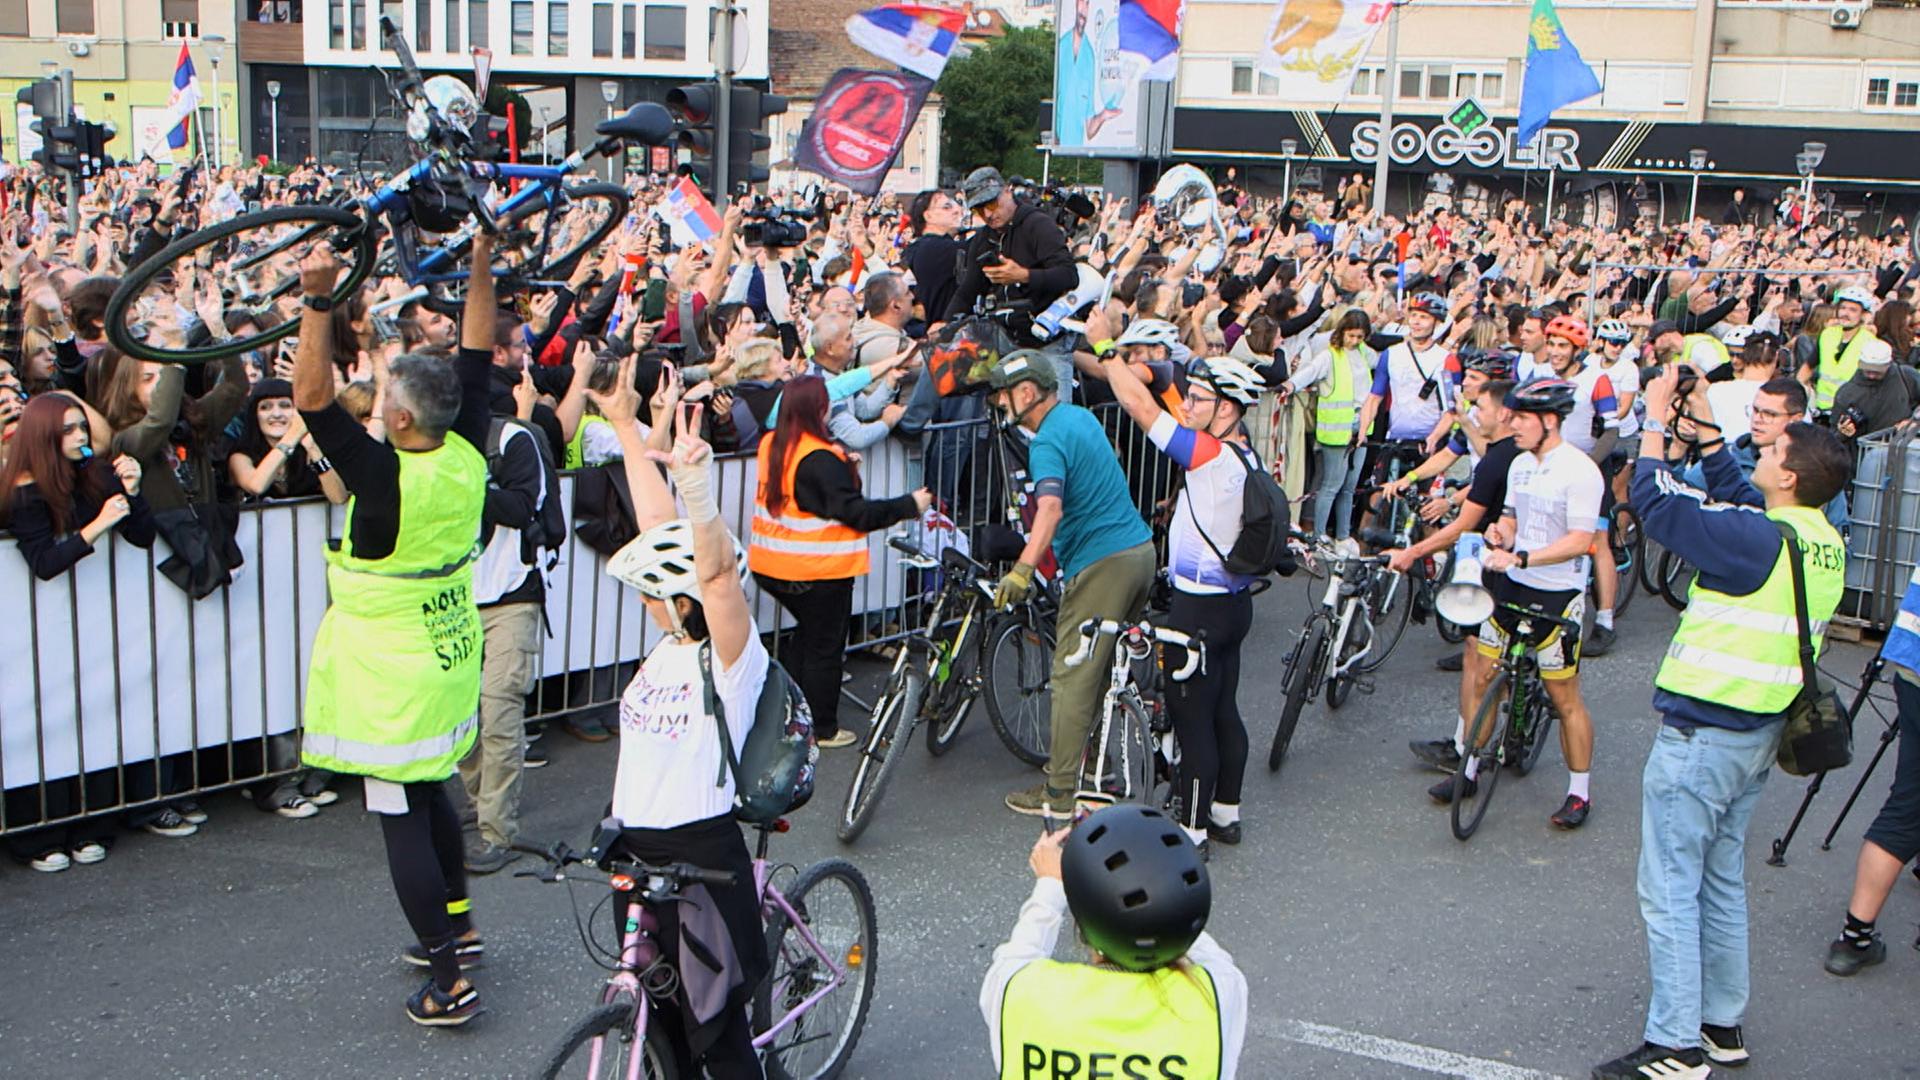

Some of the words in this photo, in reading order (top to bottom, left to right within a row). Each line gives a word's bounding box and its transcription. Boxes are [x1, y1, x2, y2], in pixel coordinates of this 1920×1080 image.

[1350, 121, 1580, 171] SOCCER
[1800, 538, 1843, 571] PRESS
[1023, 1043, 1188, 1080] PRESS
